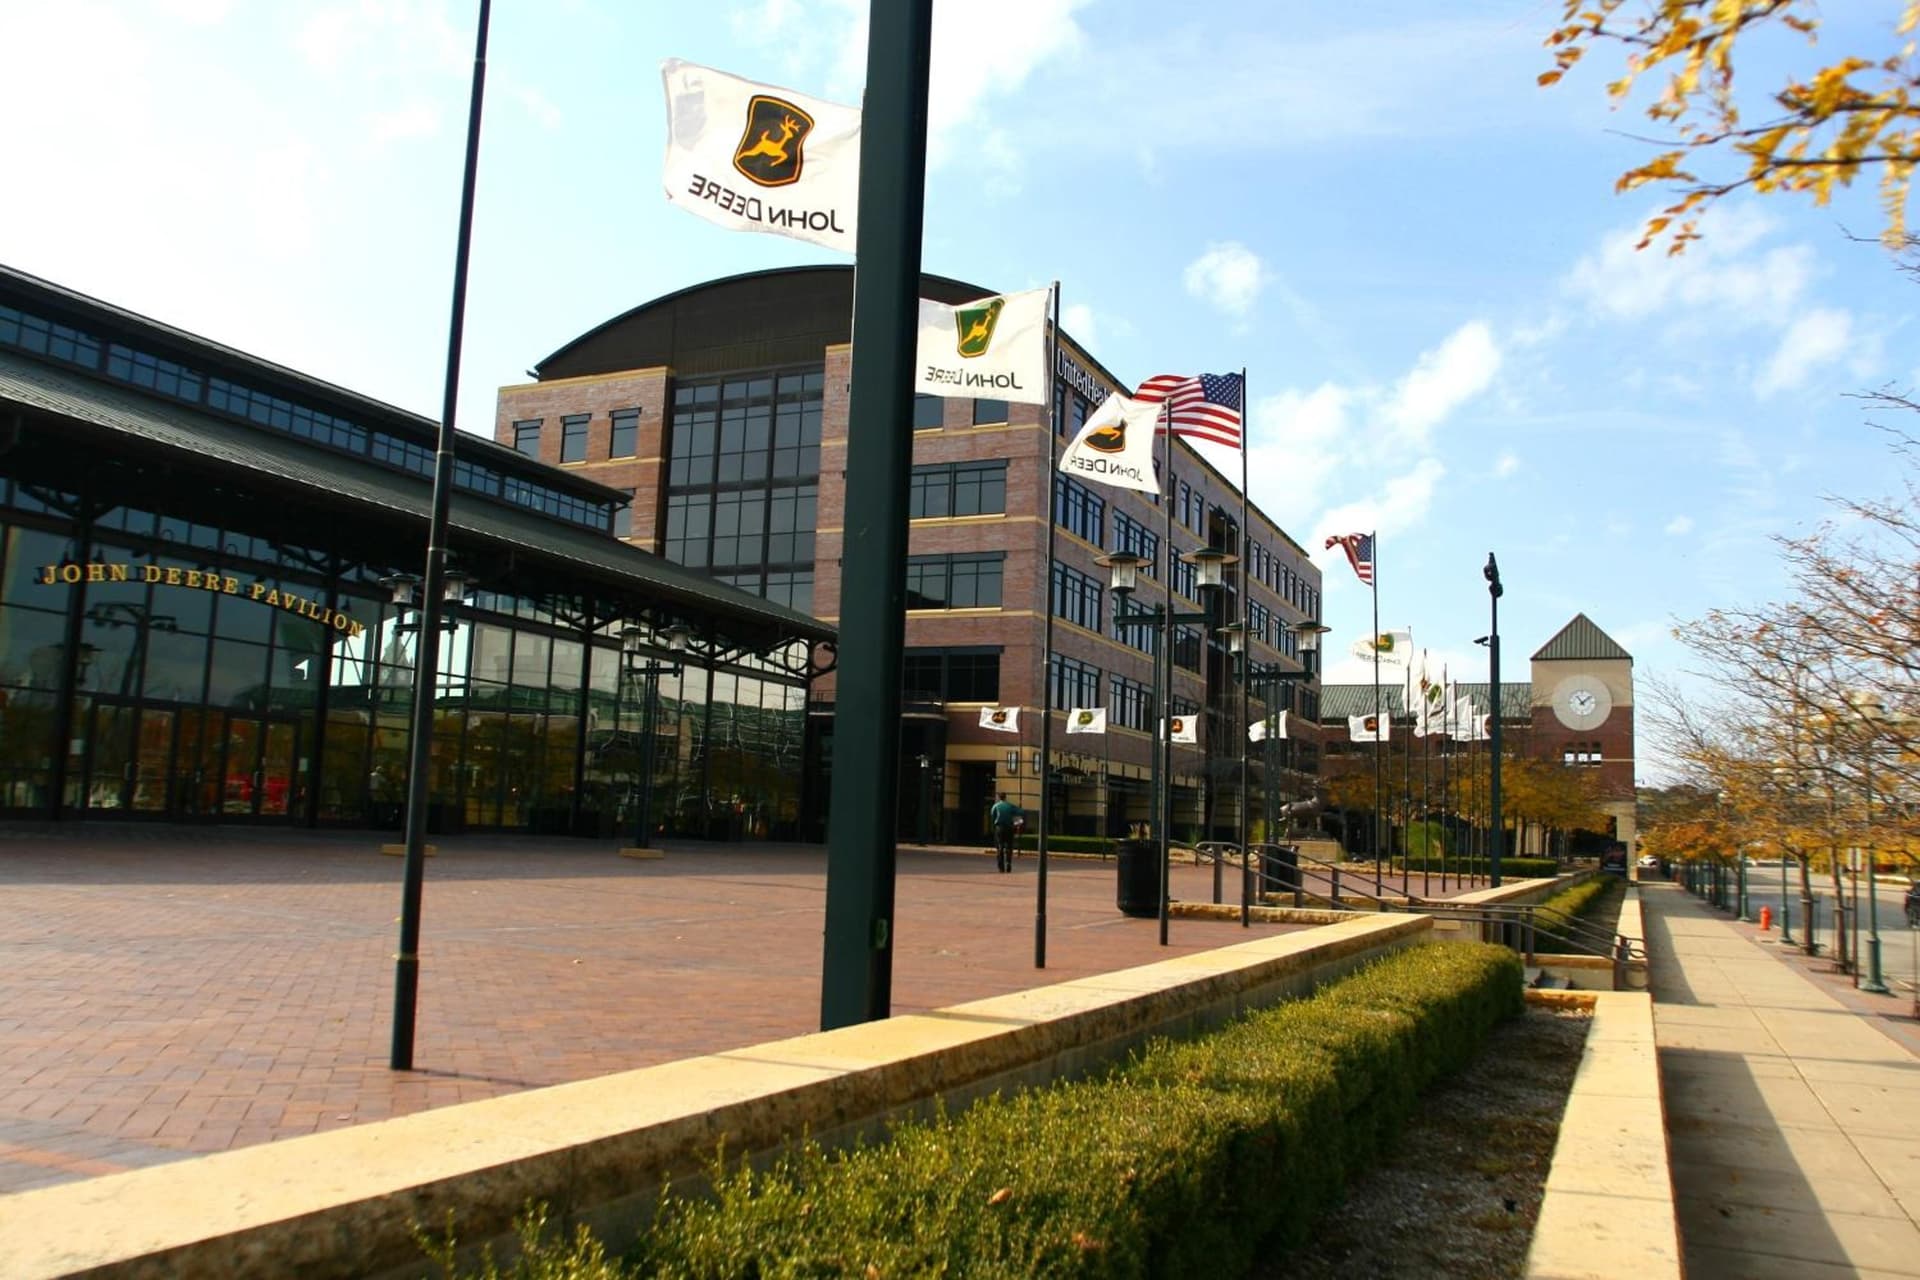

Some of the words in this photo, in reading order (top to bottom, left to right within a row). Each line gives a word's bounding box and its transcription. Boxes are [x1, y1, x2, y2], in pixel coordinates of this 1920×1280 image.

[1056, 347, 1112, 406] UnitedHeal
[43, 564, 128, 586] JOHN
[144, 564, 239, 595] DEERE
[250, 583, 366, 639] PAVILION
